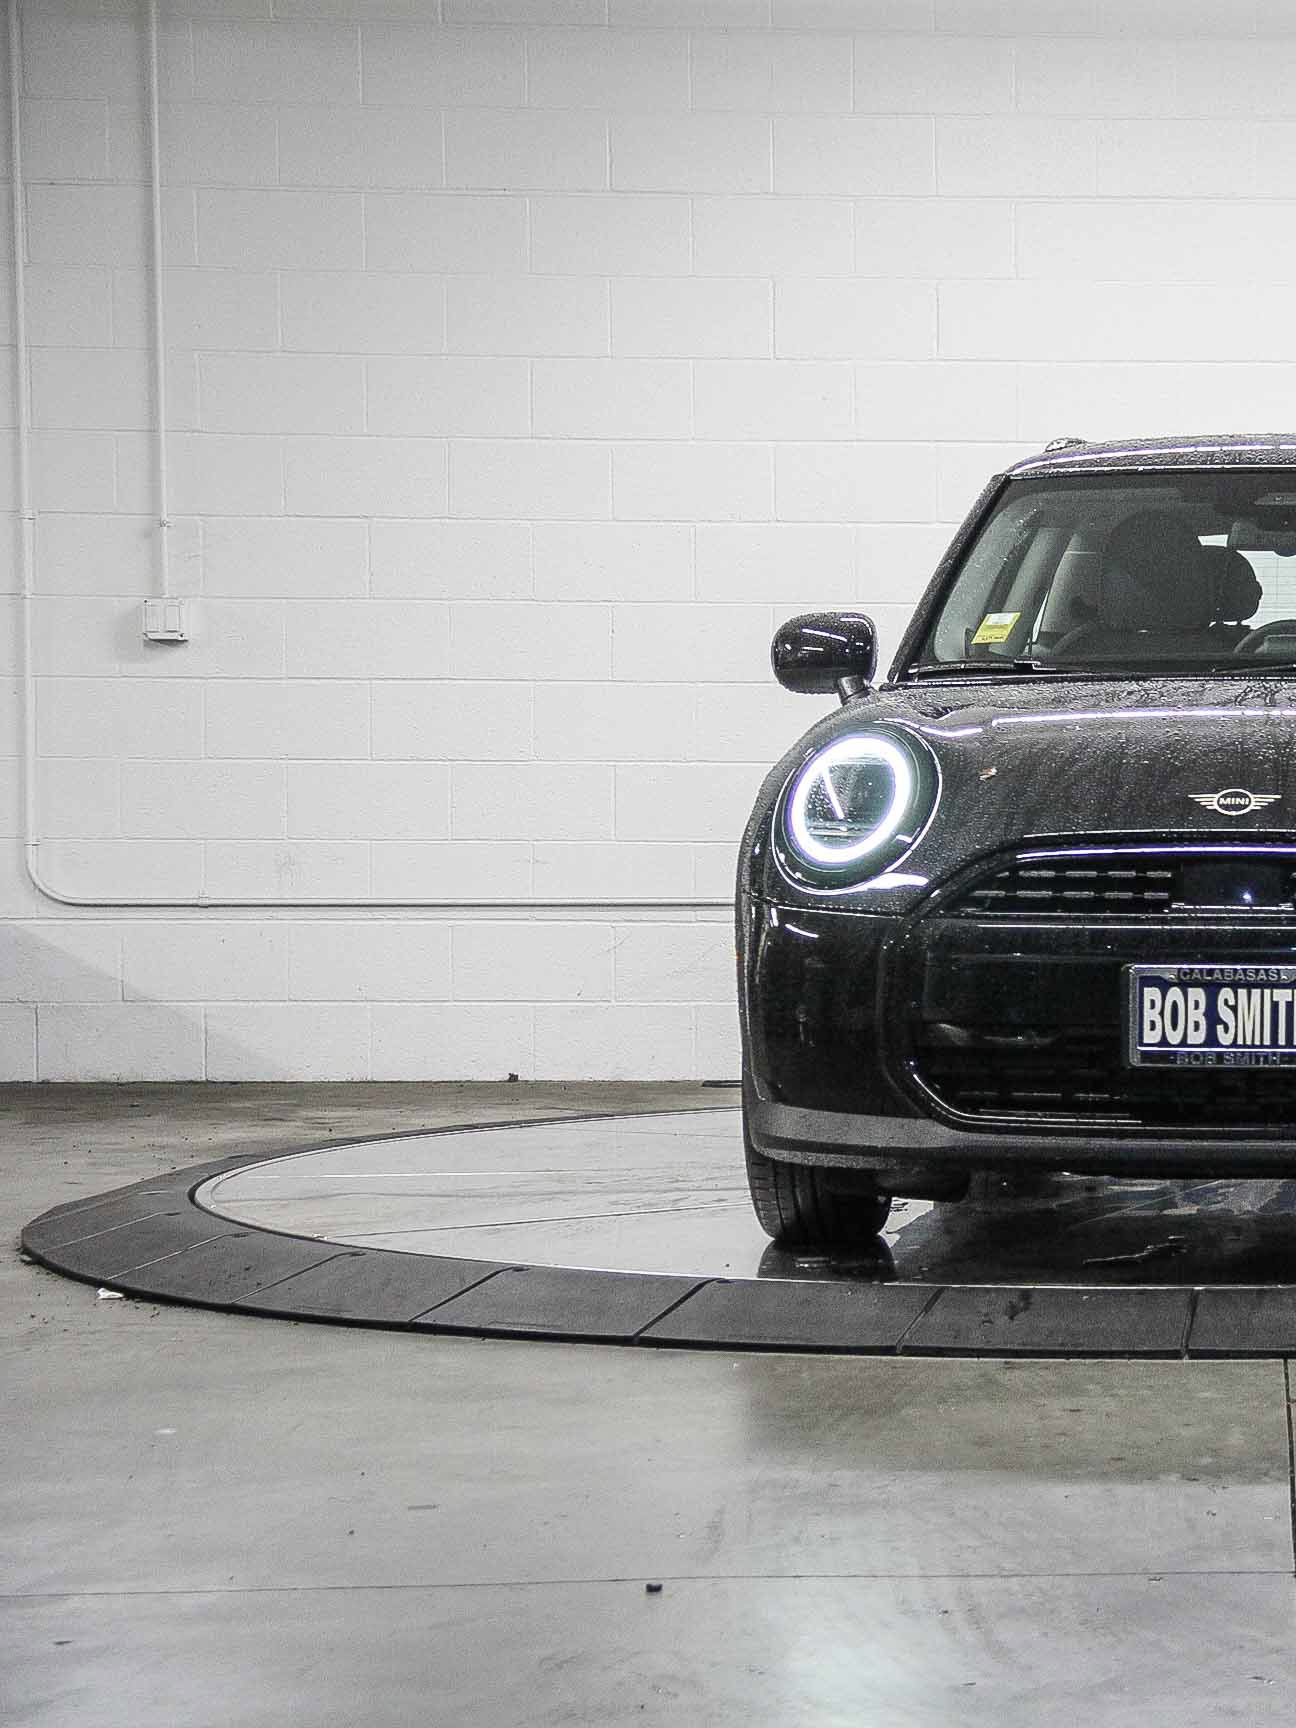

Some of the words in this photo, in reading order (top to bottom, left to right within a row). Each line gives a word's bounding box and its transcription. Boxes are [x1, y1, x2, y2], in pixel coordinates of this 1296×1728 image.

[1218, 797, 1250, 805] MINI
[1179, 968, 1279, 981] CALABASAS
[1143, 987, 1207, 1045] BOB
